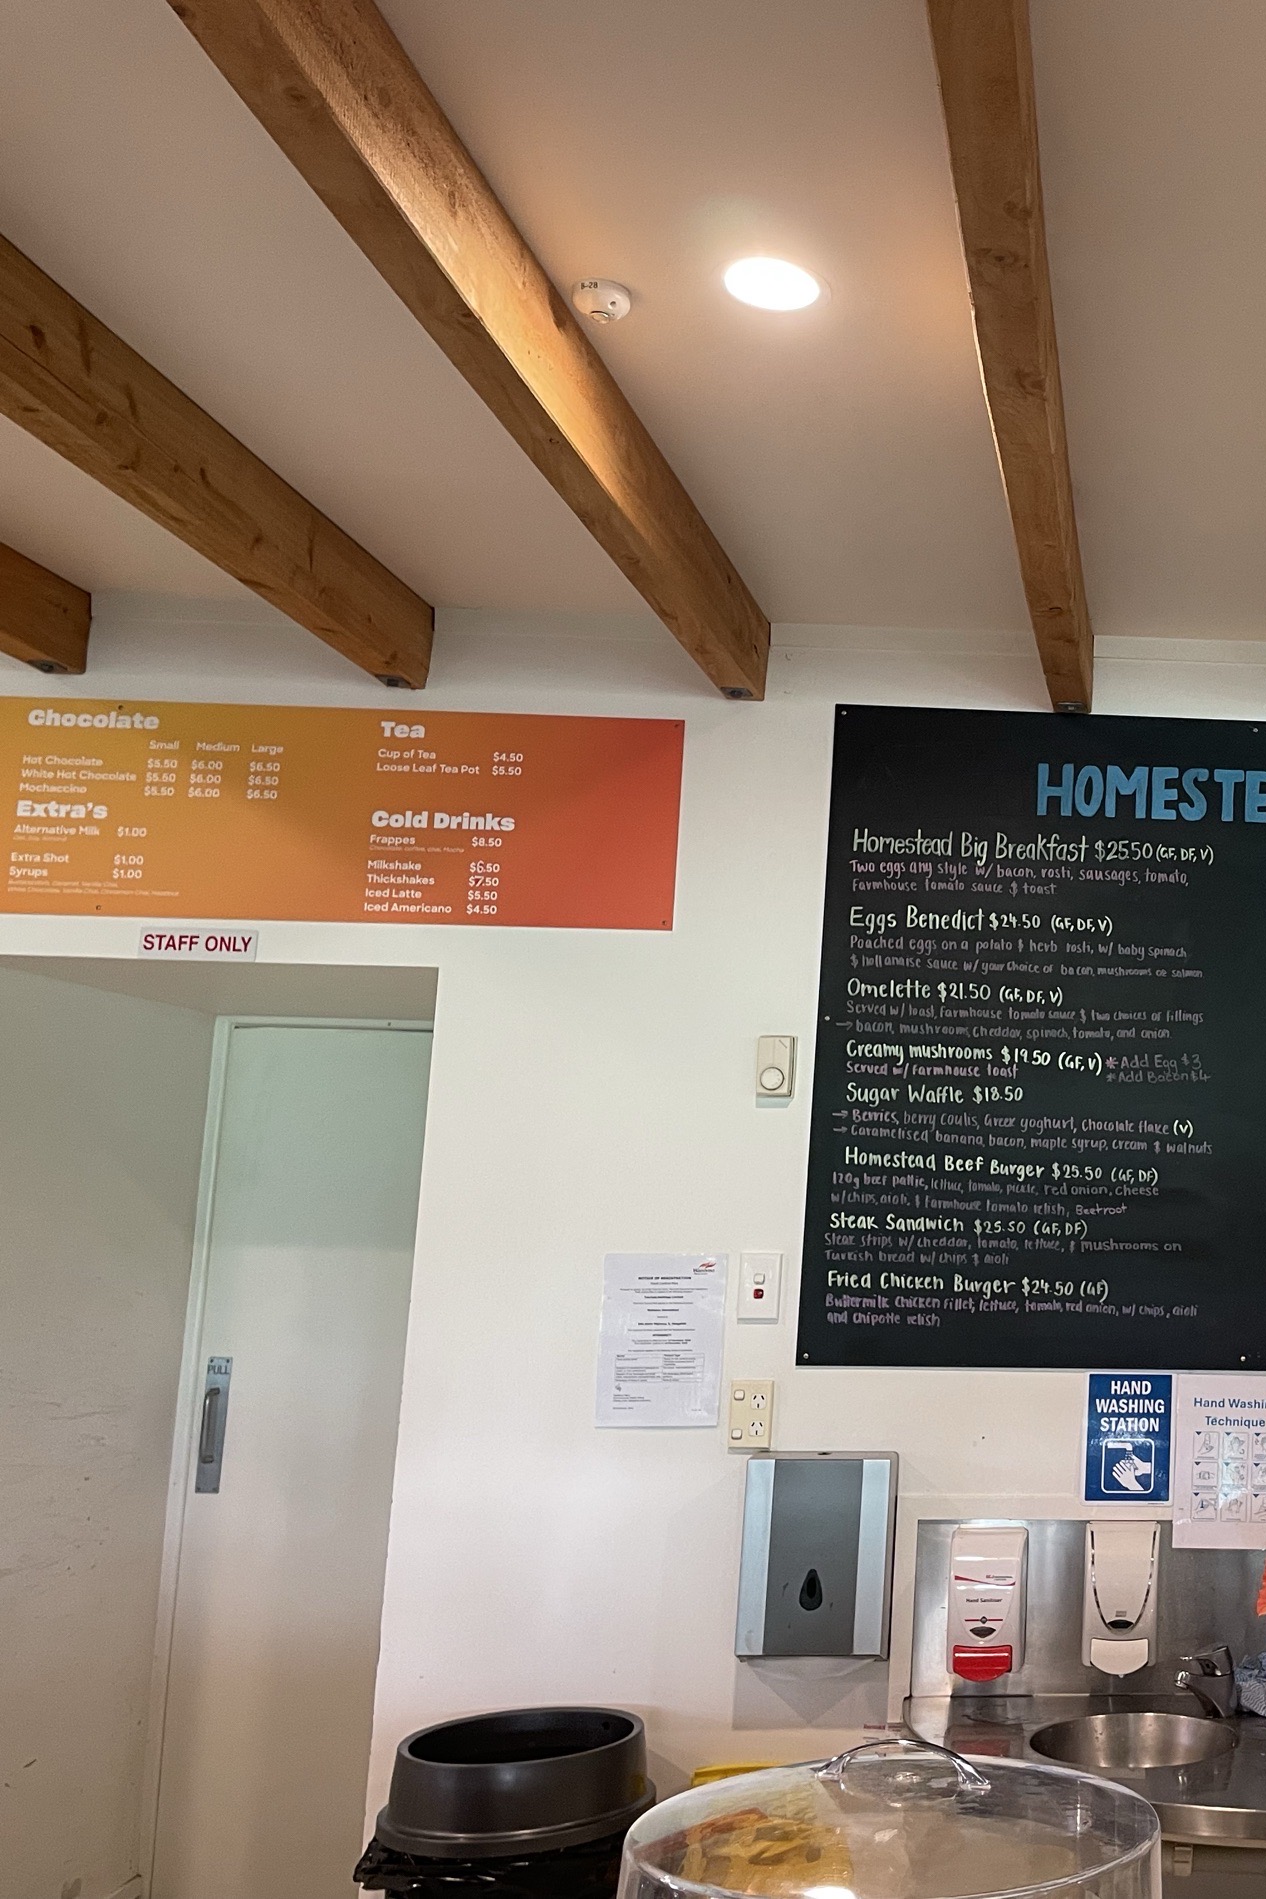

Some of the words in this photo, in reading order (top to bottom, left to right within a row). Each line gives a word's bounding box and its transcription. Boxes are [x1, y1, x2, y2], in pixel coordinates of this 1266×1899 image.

[28, 709, 159, 730] Chocolate
[381, 721, 425, 738] Tea
[149, 741, 180, 750] Small
[196, 742, 240, 752] Medium
[251, 744, 284, 754] Large
[378, 749, 400, 759] Cup
[403, 749, 414, 758] of
[418, 750, 436, 759] Tea
[493, 752, 523, 762] $4.50
[22, 756, 42, 765] Hot
[45, 756, 103, 766] Chocolate
[148, 759, 177, 769] $5.50
[191, 760, 222, 771] $6.00
[250, 762, 280, 772] $6.50
[377, 763, 409, 772] Loose
[413, 764, 436, 773] Leaf
[440, 765, 458, 774] Tea
[461, 765, 480, 774] Pot
[492, 766, 521, 776] $5.50
[22, 769, 54, 779] White
[57, 770, 76, 780] Hot
[79, 771, 136, 781] Chocolate
[190, 774, 221, 784] $6.00
[248, 775, 278, 786] $6.50
[19, 783, 87, 794] Mochaccino
[188, 787, 220, 798] $6.00
[247, 789, 277, 799] $6.50
[16, 800, 107, 819] Extra's
[372, 811, 427, 828] Cold
[434, 813, 515, 831] Drinks
[14, 824, 76, 836] Alternative
[79, 826, 100, 836] Milk
[118, 827, 147, 837] $1.00
[370, 835, 415, 846] Frappes
[472, 837, 502, 848] $8.50
[852, 828, 953, 857] Homestead
[961, 832, 987, 866] Big
[995, 834, 1089, 862] Breakfast
[11, 852, 40, 863] Extra
[44, 853, 69, 863] Shot
[114, 855, 143, 865] $1.00
[9, 866, 48, 878] Syrups
[113, 869, 142, 879] $1.00
[368, 860, 422, 871] Milkshake
[470, 861, 500, 873] $6.50
[367, 875, 435, 885] Thickshakes
[469, 876, 499, 888] $7.50
[365, 888, 389, 898] Iced
[393, 889, 422, 899] Latte
[468, 890, 497, 901] $5.50
[364, 902, 388, 912] Iced
[391, 903, 452, 914] Americano
[466, 904, 497, 915] $4.50
[850, 906, 897, 934] Eggs
[906, 904, 984, 932] Benedict
[989, 913, 1041, 931] $24.50
[143, 934, 200, 952] STAFF
[205, 936, 252, 952] ONLY
[847, 978, 931, 1000] Omelette
[937, 983, 991, 1002] $21.50
[846, 1082, 899, 1107] Sugar
[907, 1086, 964, 1104] Waffle
[973, 1087, 1024, 1103] $18.50
[845, 1147, 936, 1171] Homestead
[944, 1155, 984, 1172] Beef
[990, 1161, 1045, 1182] Burger
[1052, 1163, 1102, 1180] $25.50
[830, 1212, 878, 1230] Steak
[886, 1216, 964, 1233] Sandwich
[974, 1219, 1026, 1236] $25.50
[827, 1270, 872, 1289] Fried
[880, 1272, 944, 1291] Chicken
[954, 1275, 1016, 1299] Burger
[1021, 1277, 1074, 1296] $24.50
[1111, 1380, 1151, 1395] HAND
[1096, 1399, 1164, 1413] WASHING
[1194, 1398, 1225, 1408] Hand
[1100, 1417, 1159, 1432] STATION
[1205, 1416, 1265, 1428] Technique
